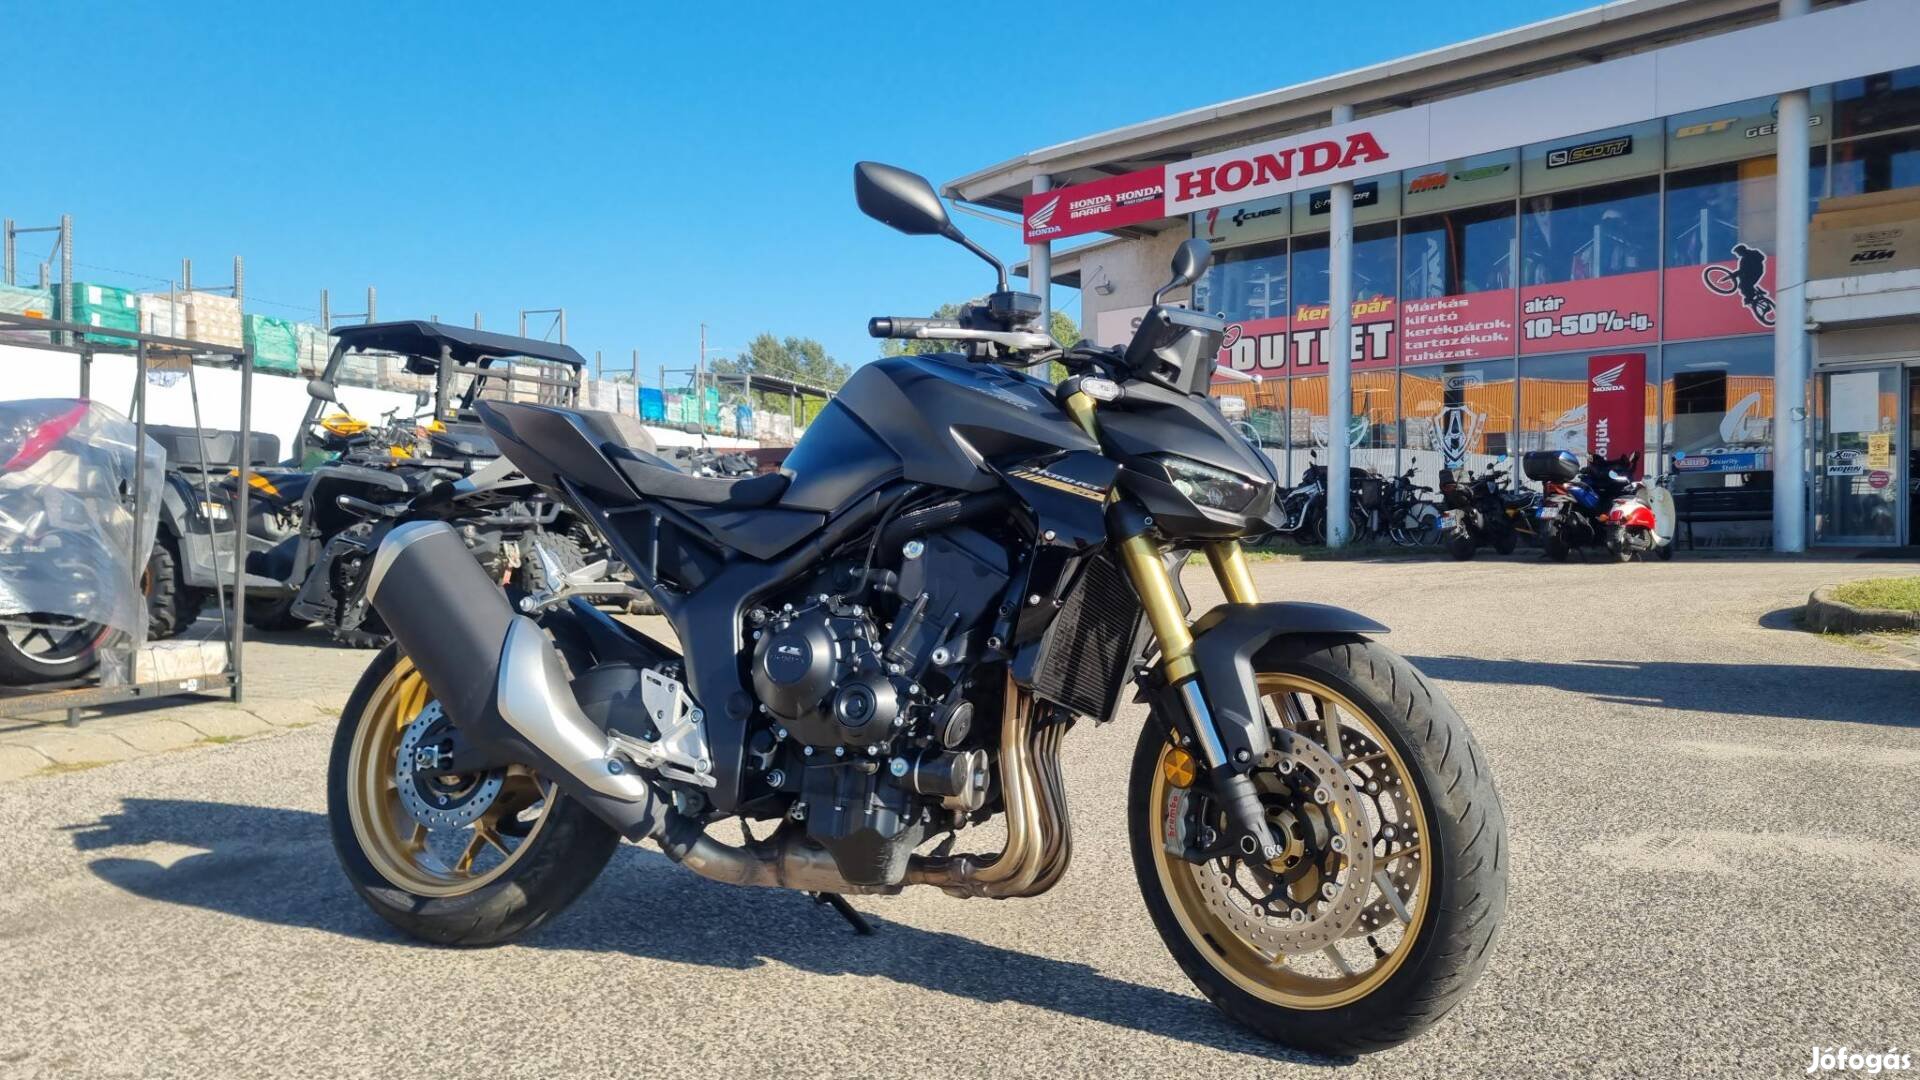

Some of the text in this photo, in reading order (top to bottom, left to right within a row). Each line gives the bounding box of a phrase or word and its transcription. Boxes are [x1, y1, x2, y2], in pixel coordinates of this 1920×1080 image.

[1571, 138, 1630, 162] SCOTT
[1174, 132, 1389, 202] HONDA
[1116, 185, 1164, 202] HONDA
[1069, 195, 1112, 210] HONDA
[1070, 204, 1112, 219] MARINE
[1243, 207, 1282, 220] CUBE
[1028, 225, 1062, 238] HONDA
[1850, 250, 1897, 262] KTM
[1297, 297, 1393, 322] kerpár
[1405, 299, 1469, 313] Márkás
[1524, 296, 1565, 314] akár
[1405, 311, 1458, 325] kifutó
